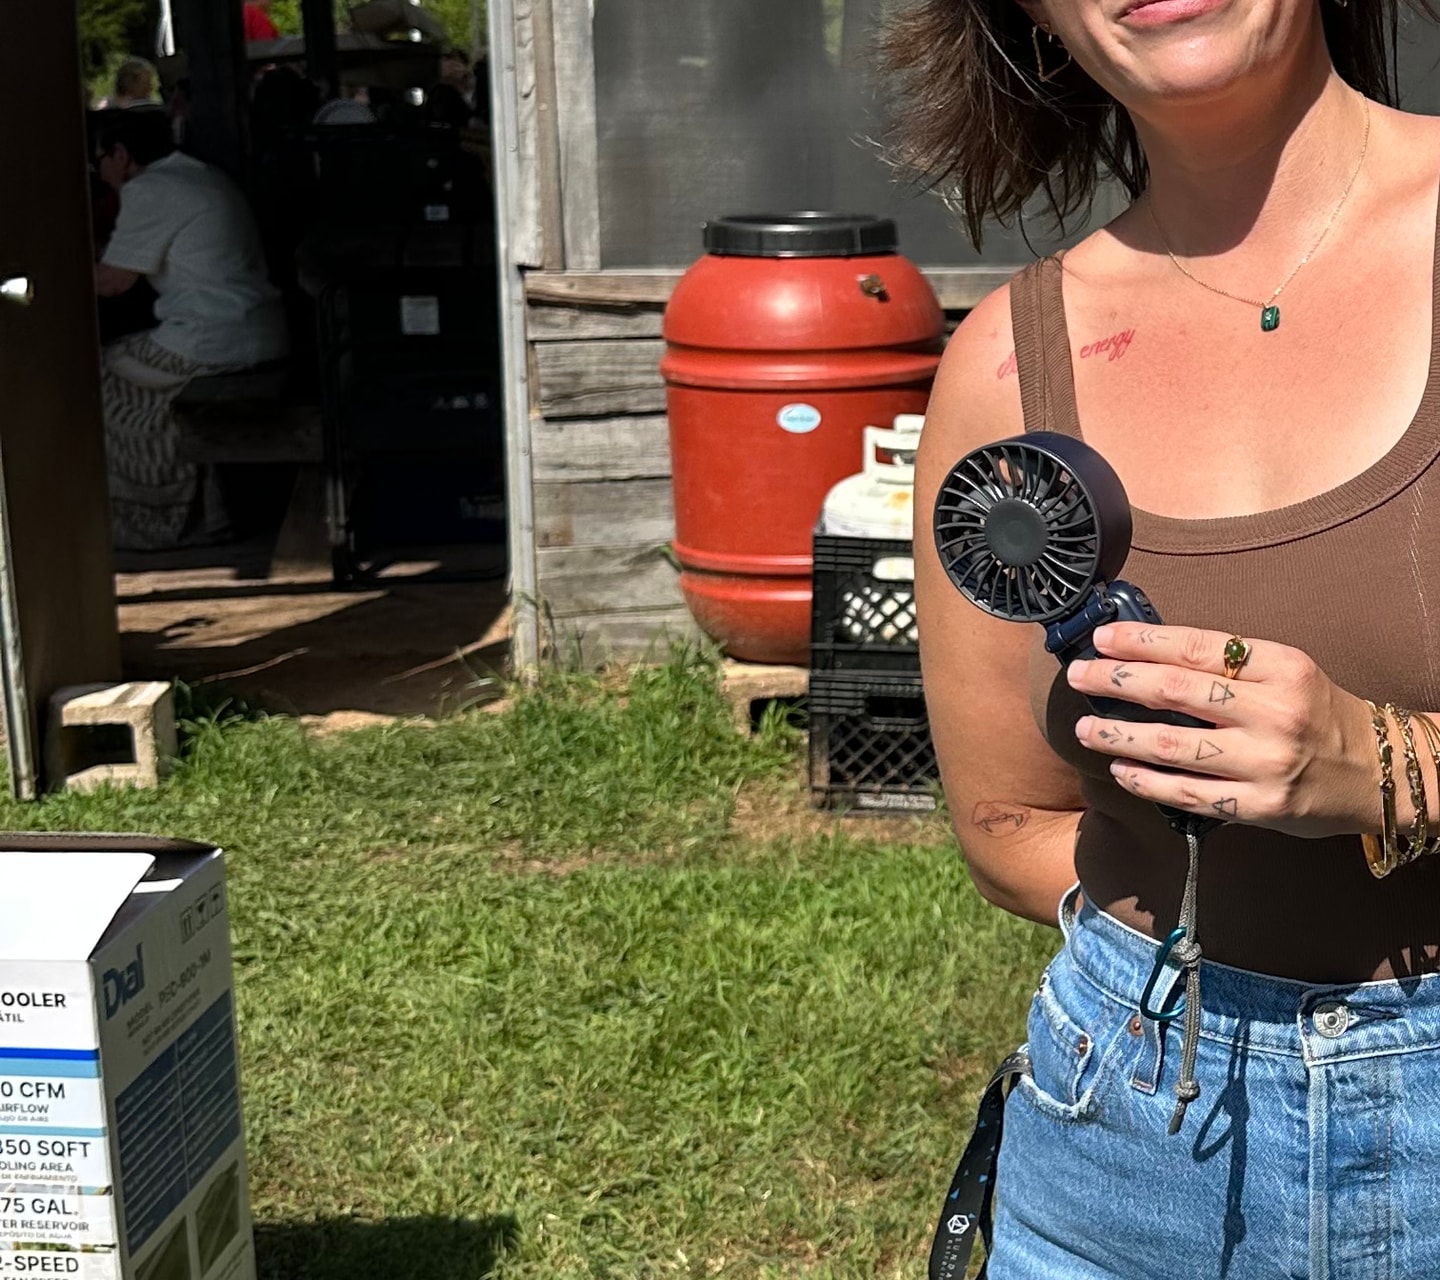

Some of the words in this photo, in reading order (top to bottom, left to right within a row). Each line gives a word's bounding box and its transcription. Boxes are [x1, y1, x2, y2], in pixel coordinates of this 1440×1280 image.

[20, 1081, 65, 1099] CFM
[0, 1103, 49, 1114] IRFLOW
[37, 1140, 91, 1158] SQFT
[40, 1162, 74, 1172] AREA
[31, 1198, 78, 1216] GAL.
[21, 1219, 89, 1231] RESERVOIR
